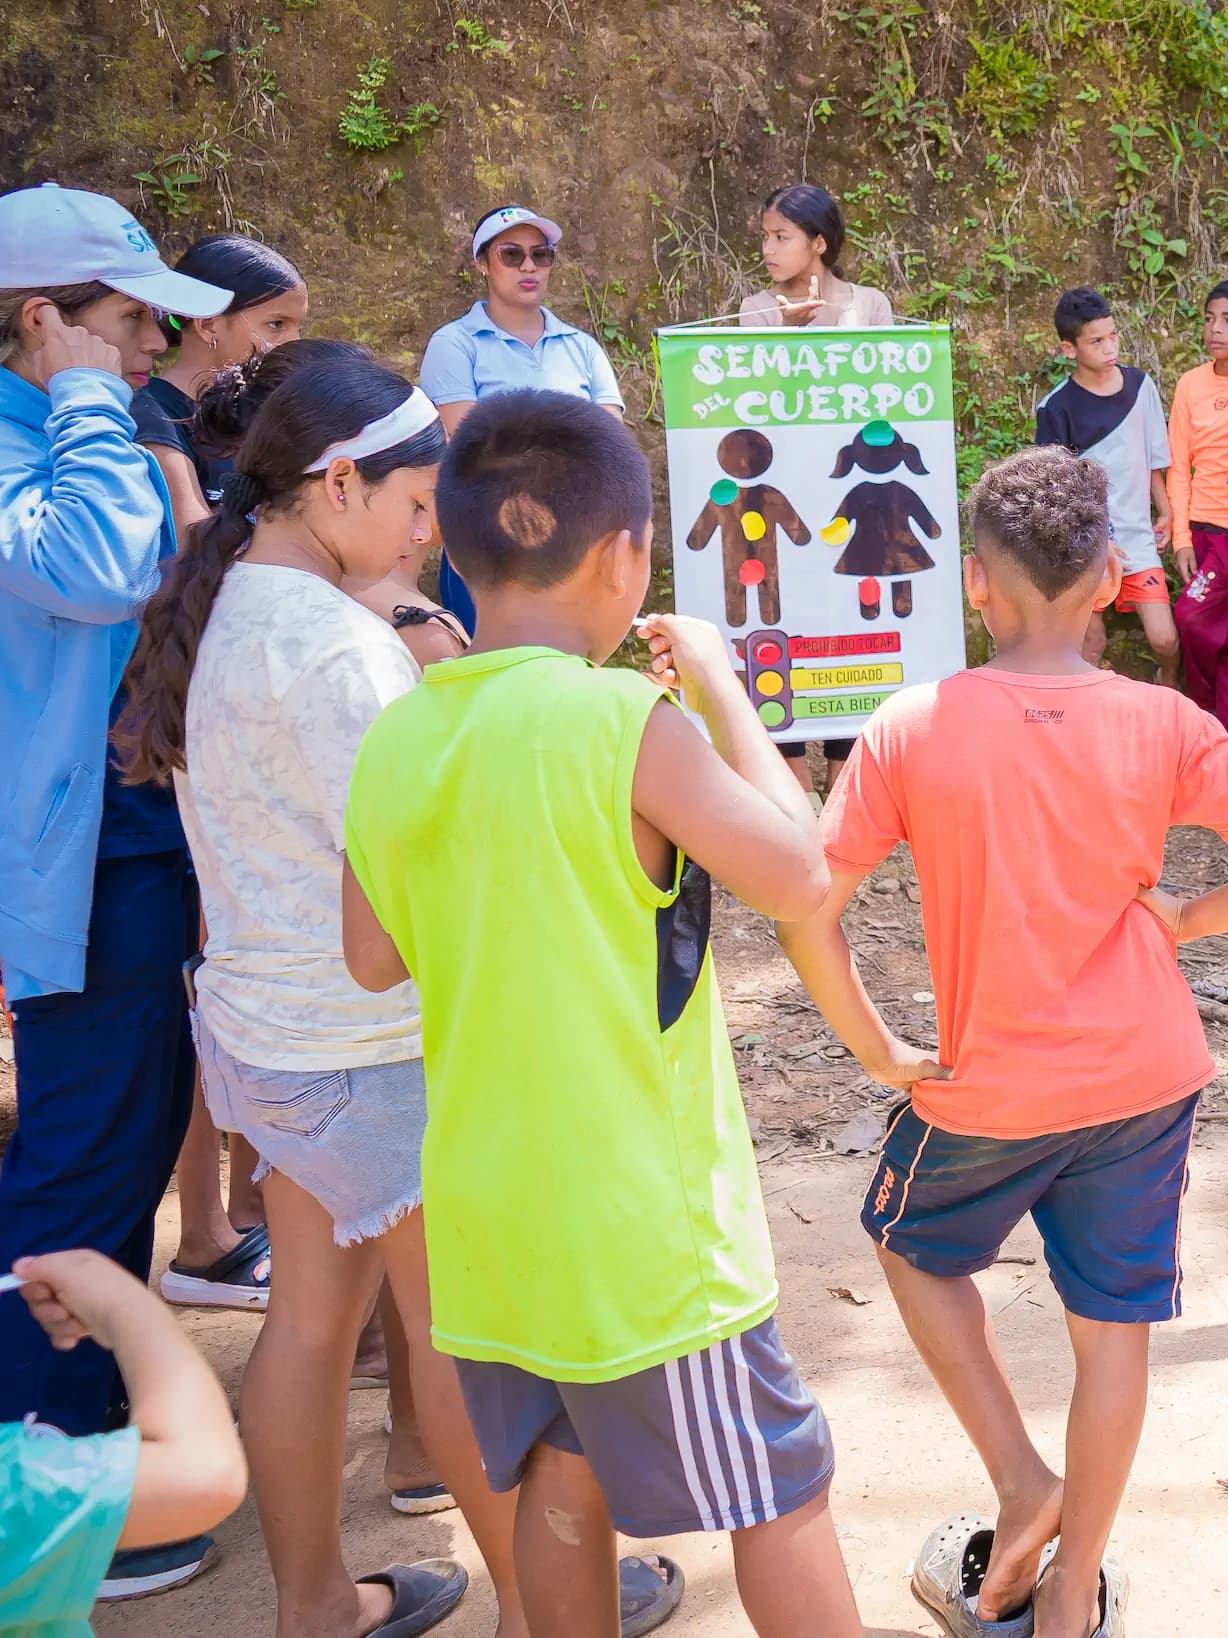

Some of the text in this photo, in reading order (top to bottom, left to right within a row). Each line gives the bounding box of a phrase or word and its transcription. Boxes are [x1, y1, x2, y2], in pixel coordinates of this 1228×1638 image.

[692, 342, 933, 385] SEMAFORO
[693, 382, 936, 424] DEL CUERPO
[795, 635, 896, 654] PROHIBIDO TOCAR
[811, 668, 883, 685] TEN CUIDADO
[809, 696, 881, 714] ESTA BIEN
